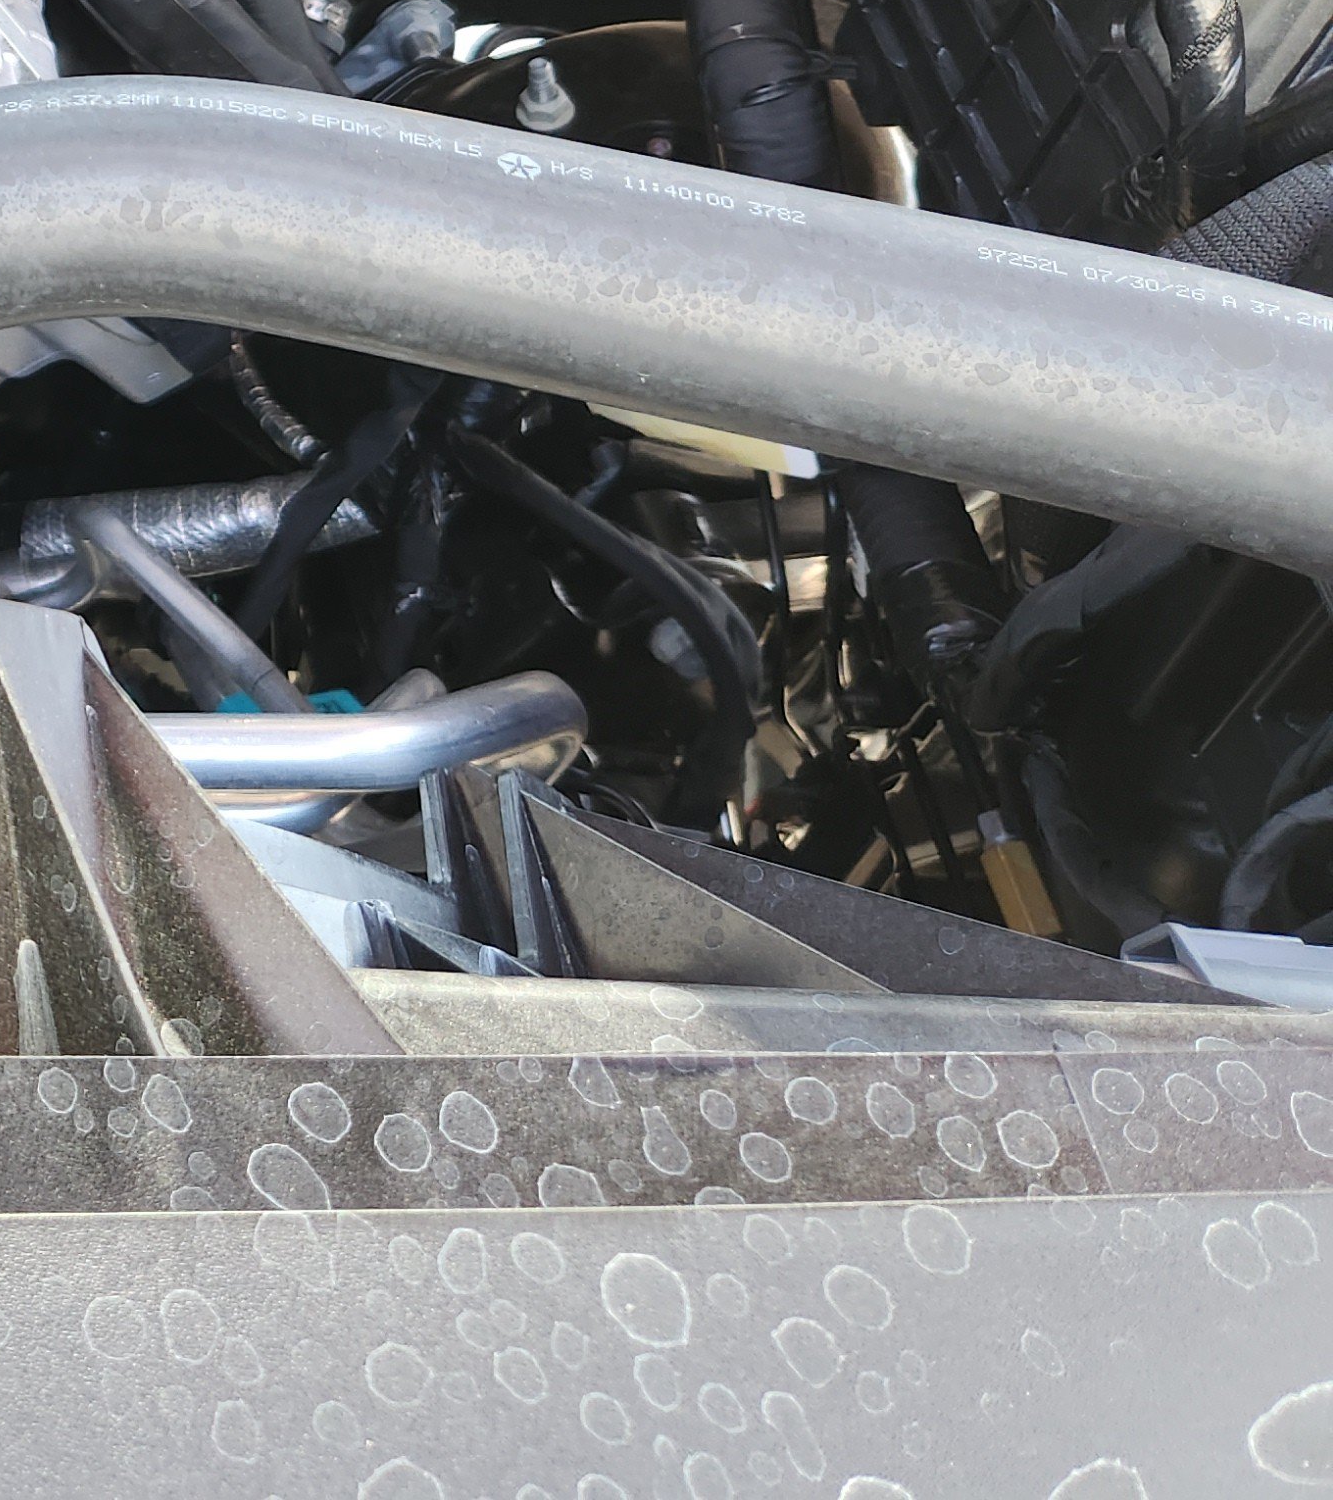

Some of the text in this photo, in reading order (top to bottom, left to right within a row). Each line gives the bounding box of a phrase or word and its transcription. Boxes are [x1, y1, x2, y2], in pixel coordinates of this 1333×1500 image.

[171, 94, 288, 122] 1101582C
[398, 130, 443, 151] MEX
[549, 160, 594, 181] H/S
[623, 175, 735, 210] 11:40:00
[747, 200, 807, 225] 3782
[976, 246, 1069, 277] 97252L
[1083, 266, 1206, 302] 07/30/26
[1221, 294, 1238, 309] A
